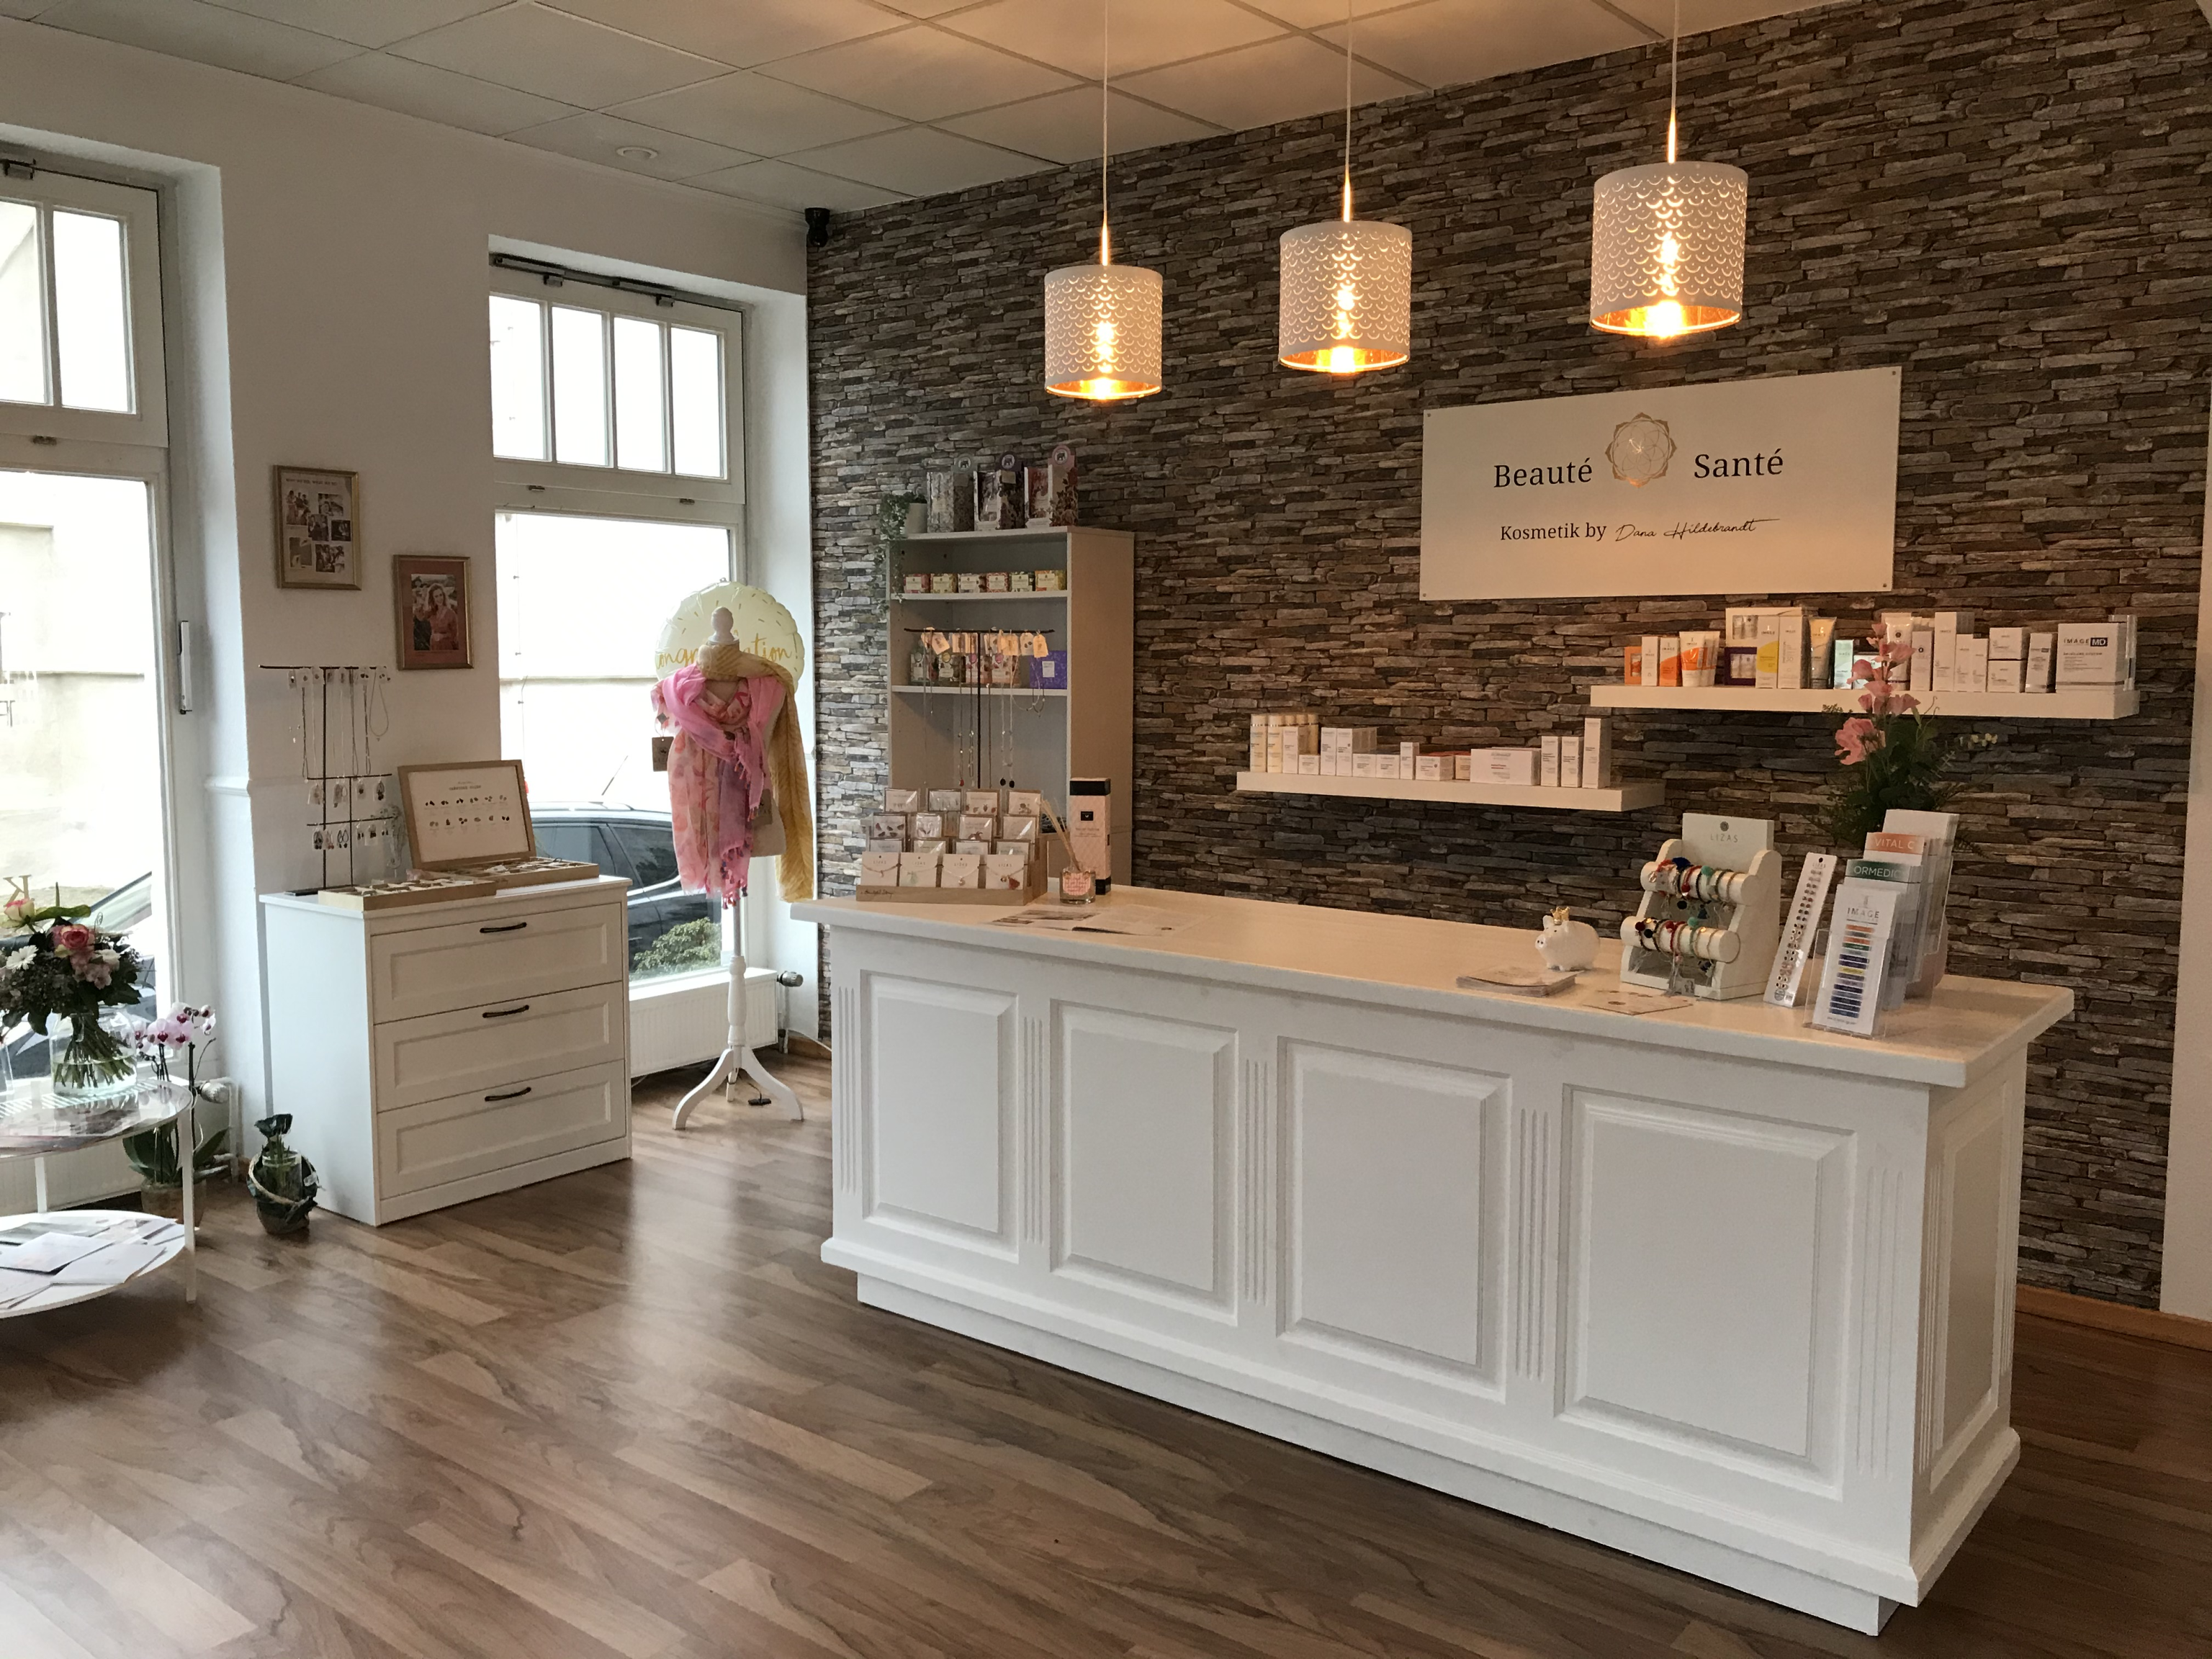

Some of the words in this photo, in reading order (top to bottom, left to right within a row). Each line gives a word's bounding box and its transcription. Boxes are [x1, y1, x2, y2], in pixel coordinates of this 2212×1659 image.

[1493, 457, 1593, 488] Beauté
[1694, 448, 1784, 479] Santé
[1500, 523, 1581, 541] Kosmetik
[1585, 522, 1607, 541] by
[1615, 524, 1658, 541] Dana
[1663, 518, 1780, 540] Hildebrandt
[1710, 833, 1738, 843] LIZAS
[1874, 838, 1904, 849] VITAL
[1907, 840, 1915, 850] C
[1853, 866, 1902, 878] ORMEDIC
[1847, 907, 1879, 919] IMAGE
